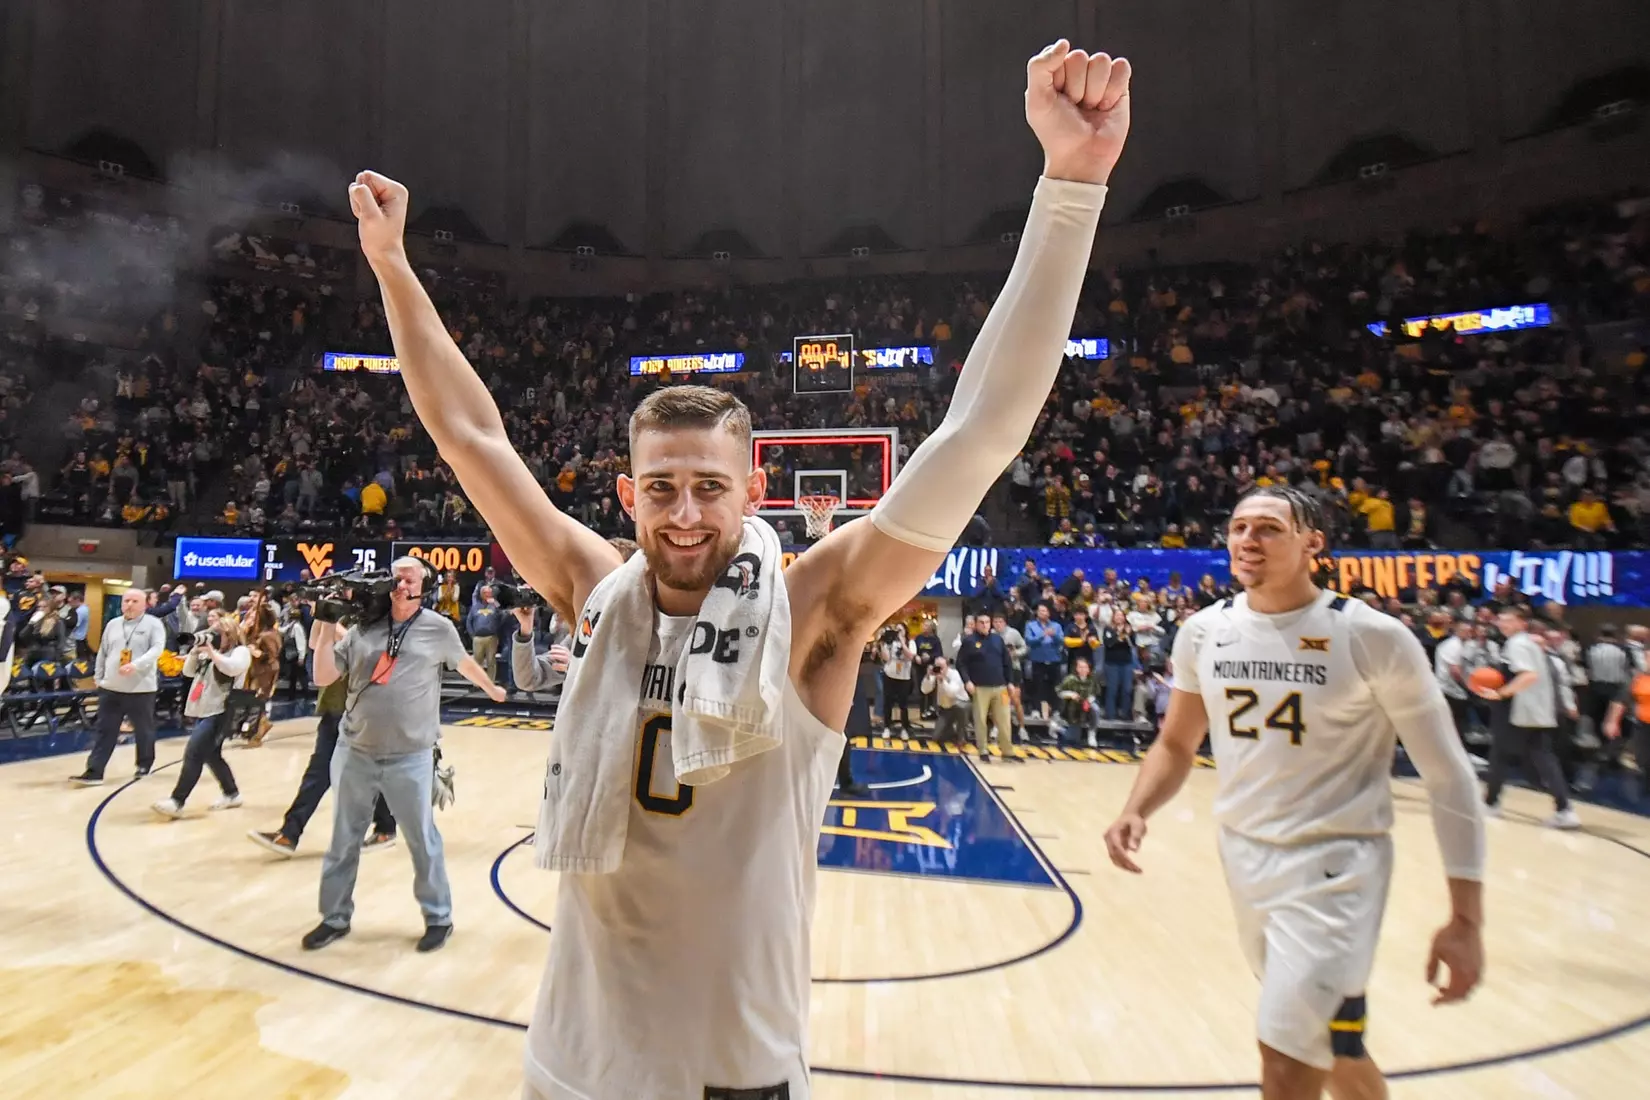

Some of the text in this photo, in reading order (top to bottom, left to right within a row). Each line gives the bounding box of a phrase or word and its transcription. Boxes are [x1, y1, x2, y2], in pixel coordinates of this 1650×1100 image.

[198, 554, 255, 568] uscellular
[1213, 660, 1327, 685] MOUNTAINEERS
[1224, 687, 1307, 746] 24
